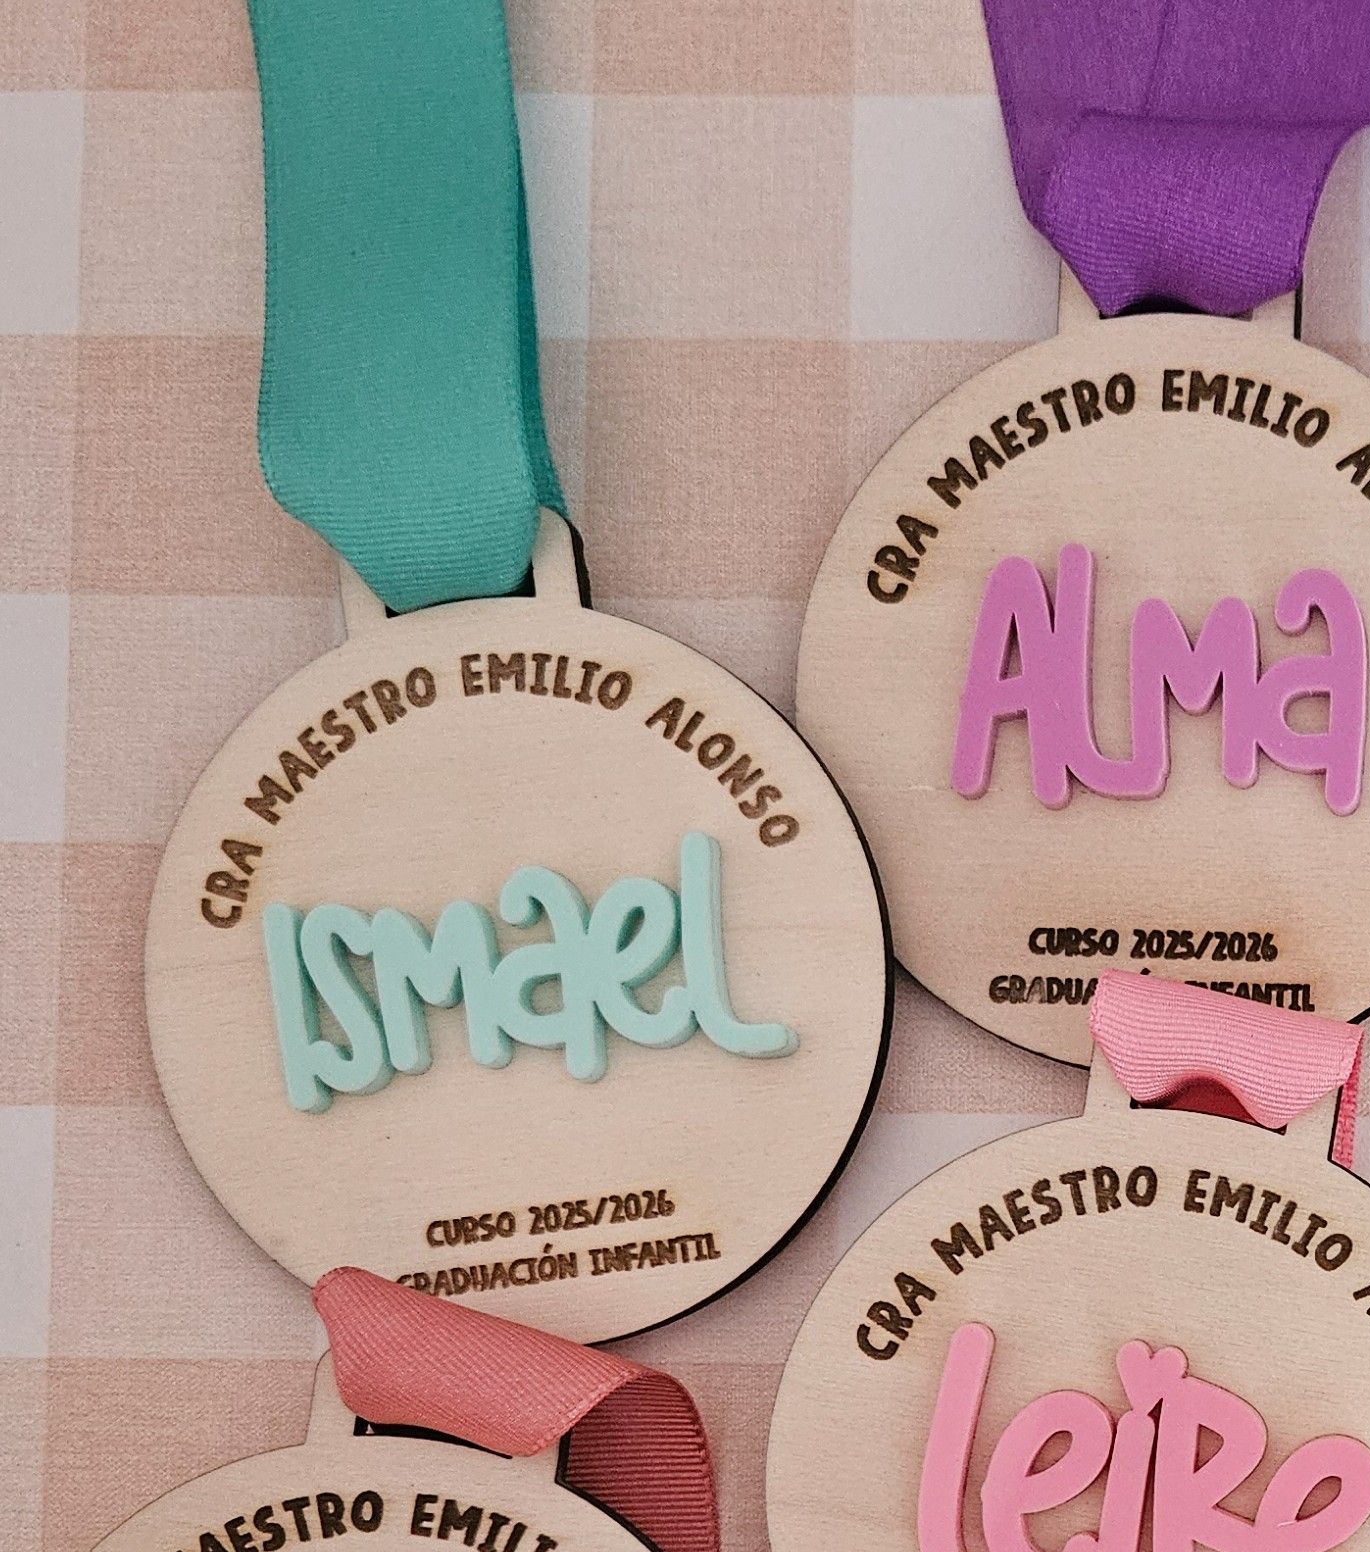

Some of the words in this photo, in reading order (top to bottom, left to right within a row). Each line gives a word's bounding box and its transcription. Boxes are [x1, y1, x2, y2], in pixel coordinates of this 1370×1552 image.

[867, 514, 939, 603] CRA
[927, 372, 1136, 509] MAESTRO
[1162, 369, 1330, 447] EMILIO
[201, 839, 263, 928] CRA
[244, 667, 436, 825] MAESTRO
[461, 653, 632, 710] EMILIO
[645, 697, 799, 847] ALONSO
[1028, 927, 1119, 957] CURSO
[1130, 929, 1278, 962] 2025/2026
[426, 1211, 516, 1247] CURSO
[528, 1189, 675, 1235] 2025/2026
[588, 1233, 721, 1276] INFANTIL
[857, 1272, 937, 1360] CRA
[931, 1165, 1158, 1275] MAESTRO
[1184, 1169, 1353, 1271] EMILIO
